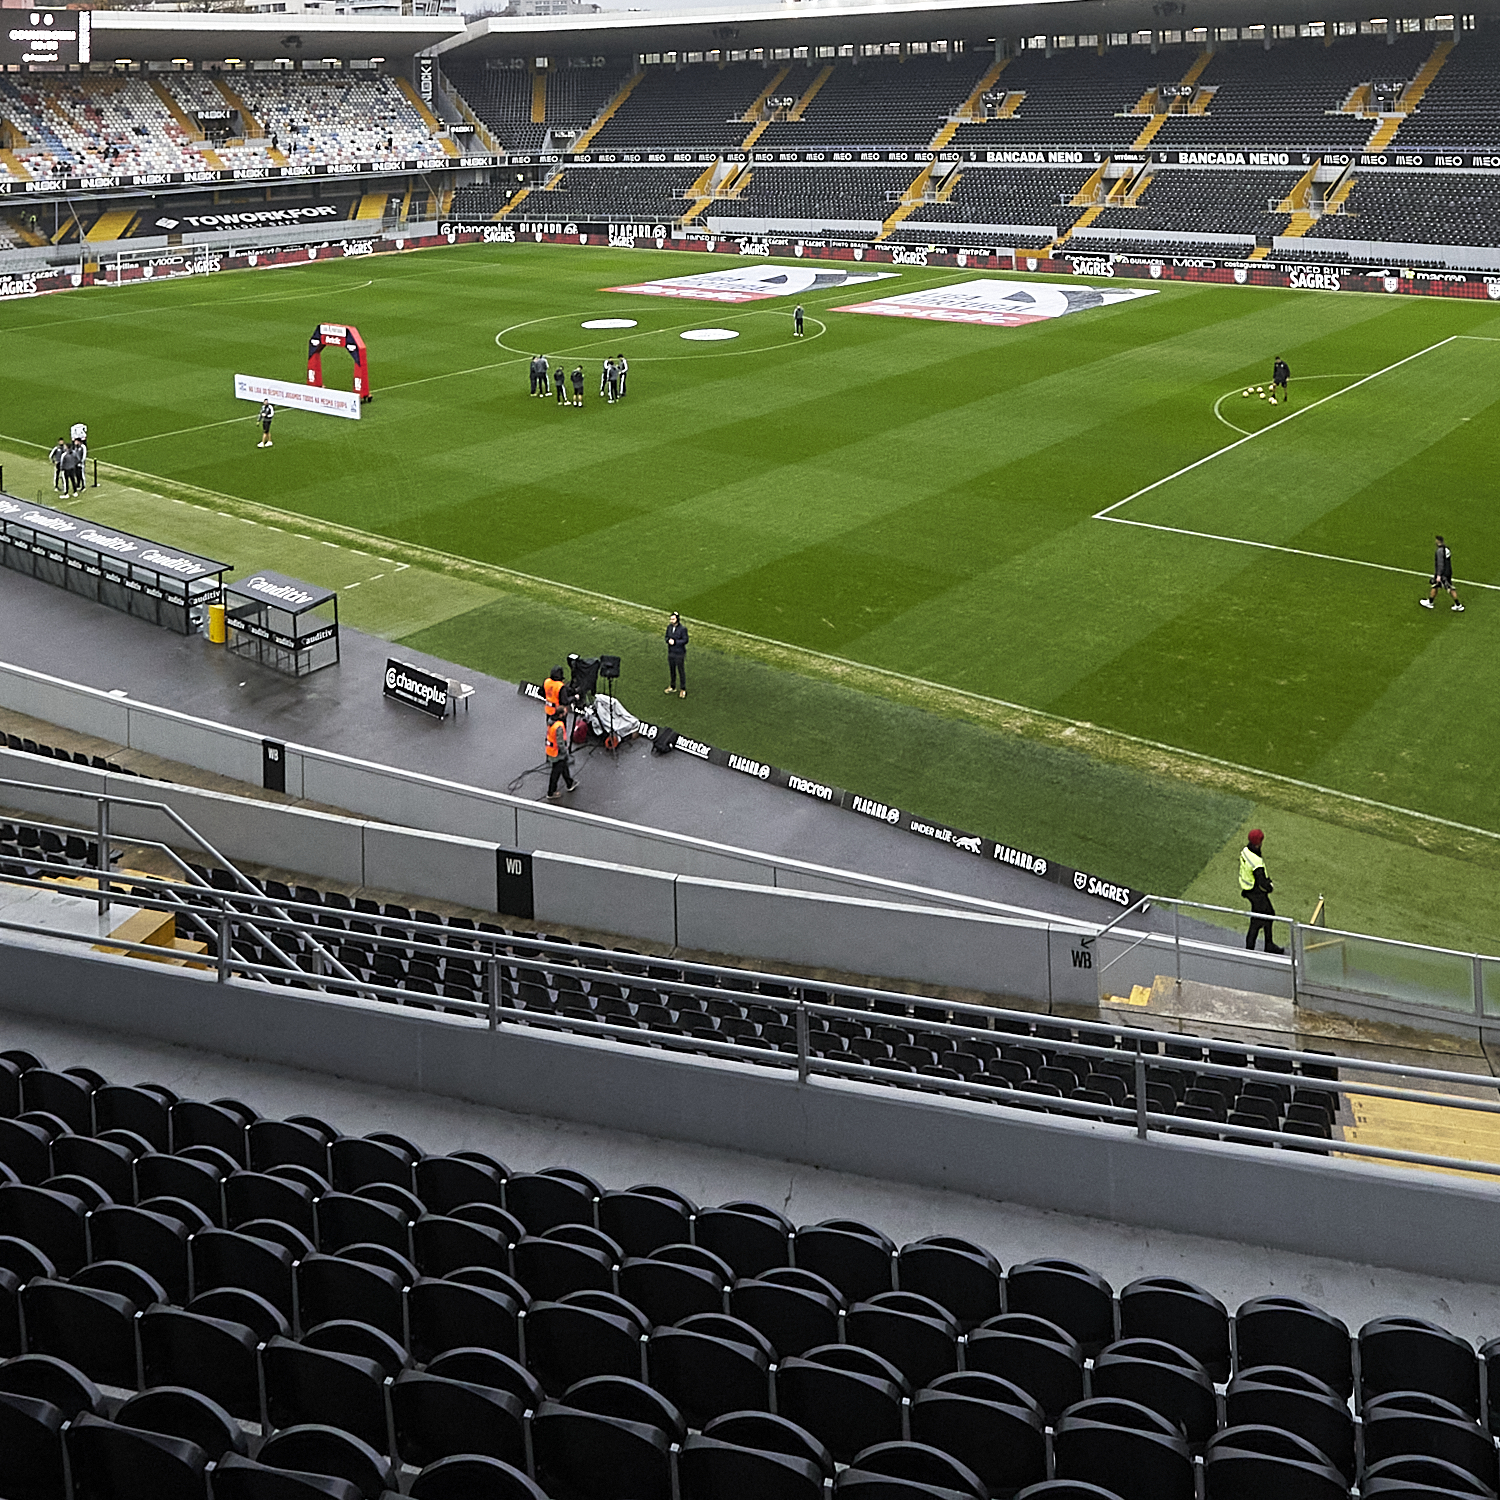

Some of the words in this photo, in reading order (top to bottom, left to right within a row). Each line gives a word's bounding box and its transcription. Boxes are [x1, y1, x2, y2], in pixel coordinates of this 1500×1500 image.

[986, 152, 1045, 163] BANCADA
[1048, 152, 1083, 163] NENO
[1178, 153, 1246, 164] BANCADA
[1249, 153, 1289, 165] NENO
[1323, 154, 1349, 164] MEO
[1361, 155, 1387, 165] MEO
[1396, 156, 1423, 166] MEO
[1435, 156, 1463, 166] MEO
[1472, 156, 1500, 167] MEO
[183, 205, 337, 227] TOWORKFOR
[739, 242, 770, 257] SAGRES
[892, 250, 928, 266] SAGRES
[1072, 260, 1115, 277] SAGRES
[1289, 272, 1341, 291] SAGRES
[396, 672, 447, 705] chanceplus
[676, 735, 711, 756] NorteCar
[788, 775, 833, 801] macron
[910, 821, 935, 838] UNDER
[935, 828, 952, 843] BLUE
[505, 857, 522, 875] WD
[1087, 877, 1131, 906] SAGRES
[1071, 950, 1092, 969] WB
